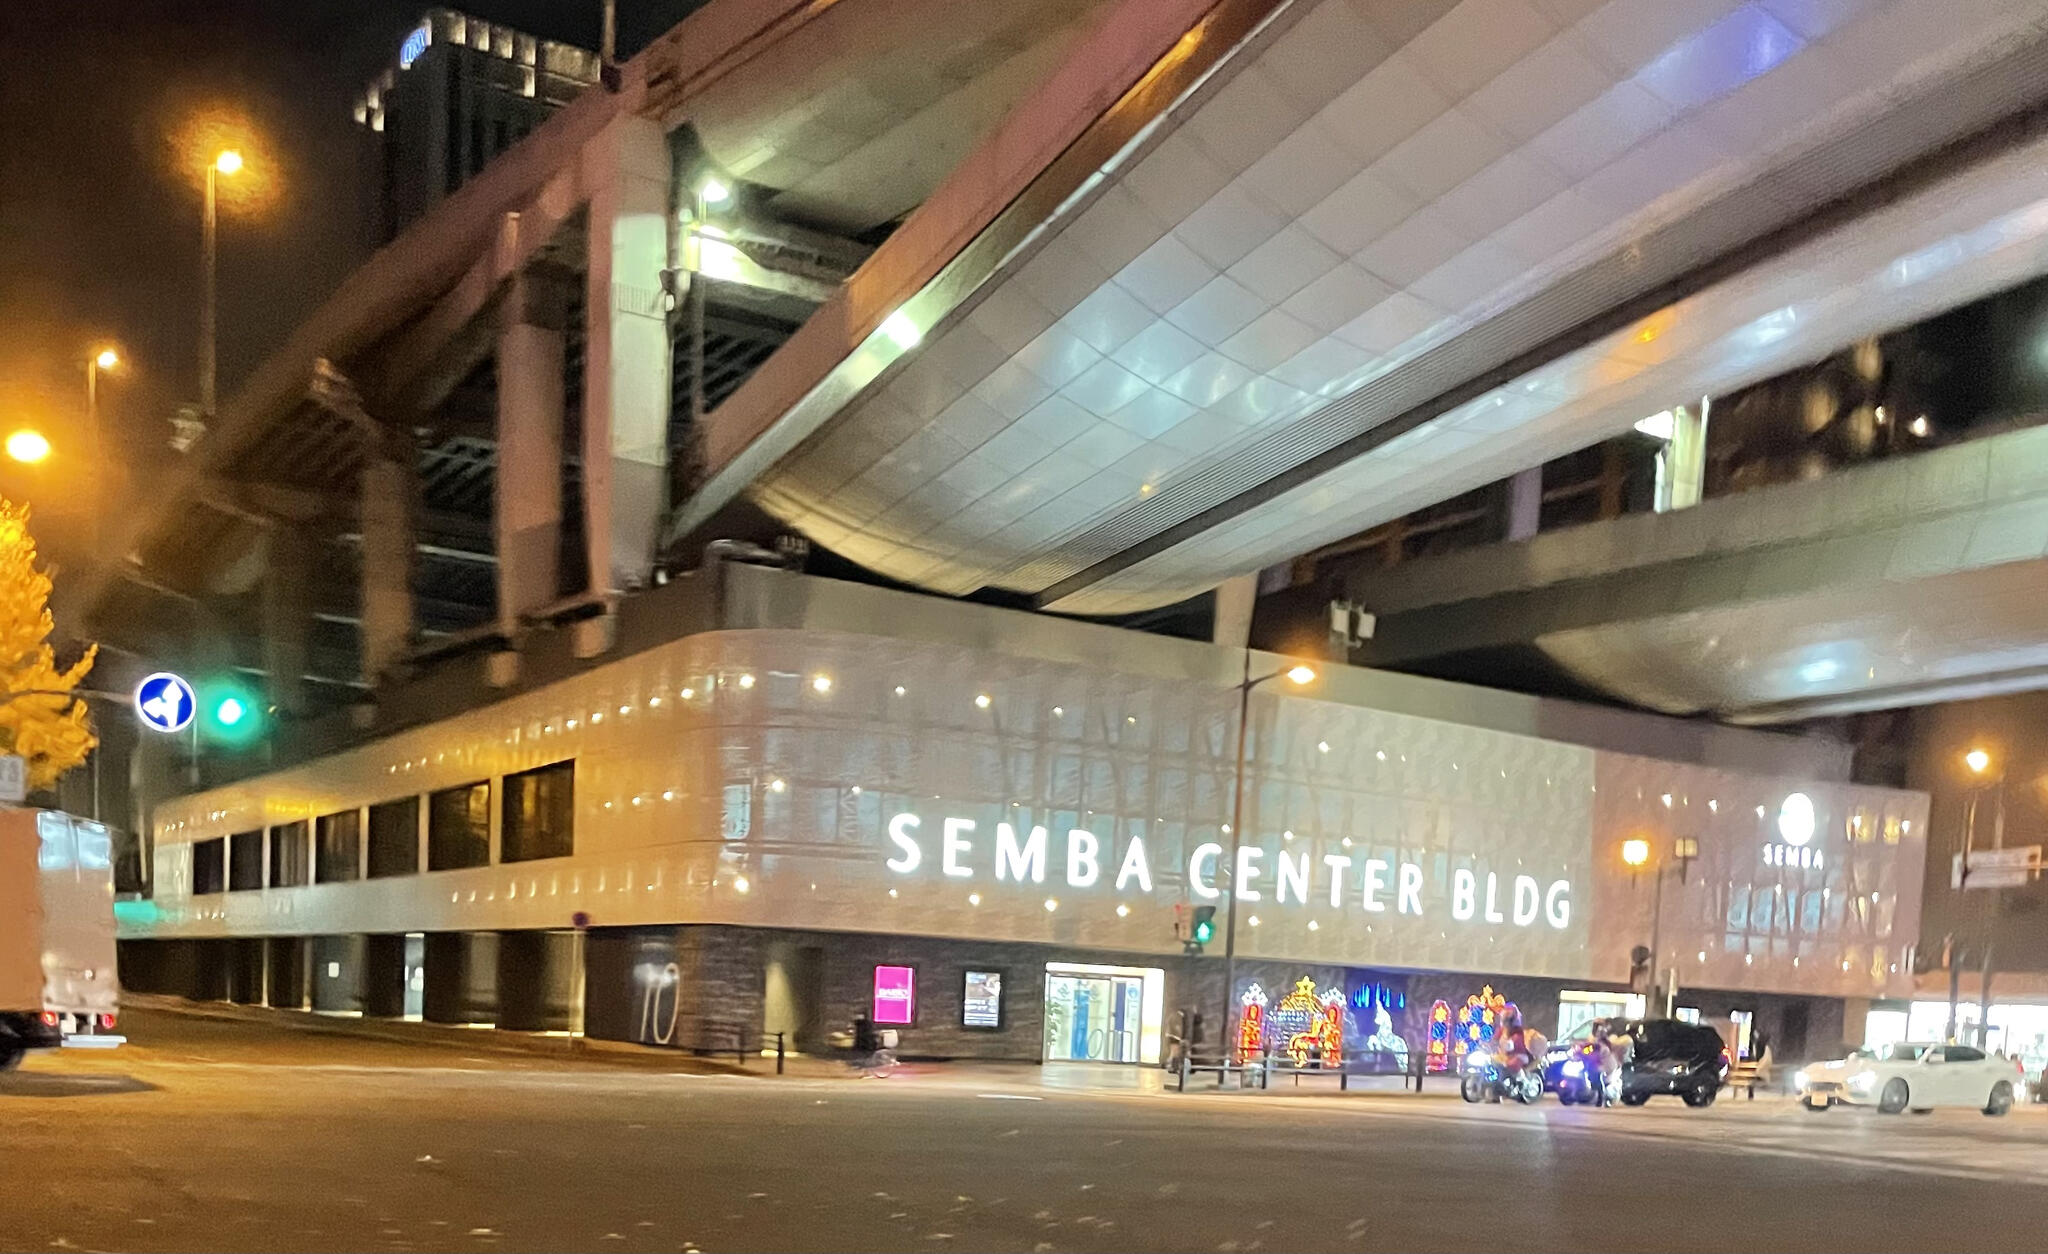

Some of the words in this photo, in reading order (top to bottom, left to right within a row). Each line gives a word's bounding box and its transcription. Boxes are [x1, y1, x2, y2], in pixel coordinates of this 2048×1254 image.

[887, 813, 1152, 891] SEMBA
[1189, 842, 1424, 916] CENTER
[1452, 868, 1570, 928] BLDG
[1763, 843, 1824, 870] SEMBA
